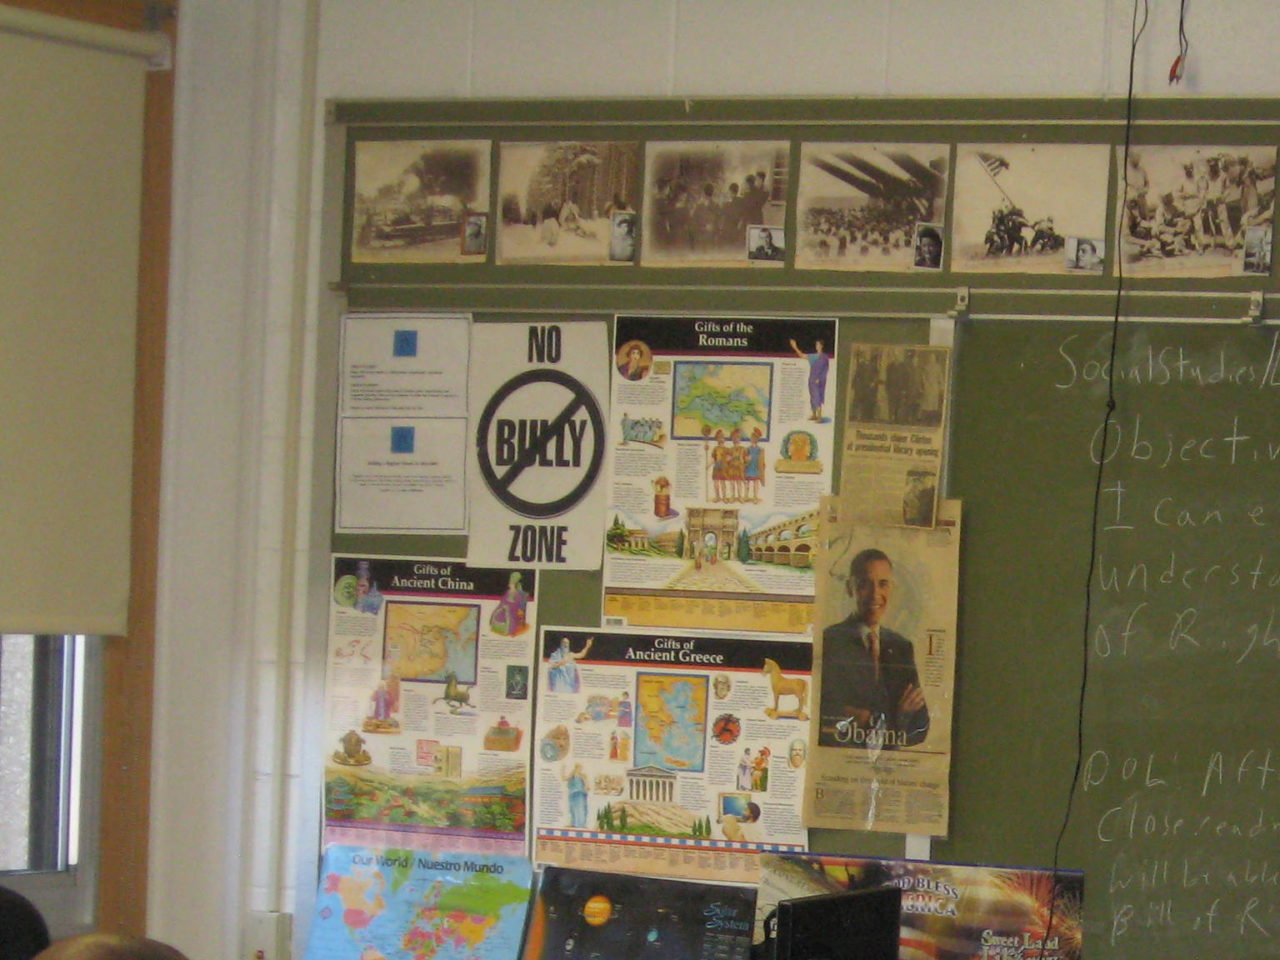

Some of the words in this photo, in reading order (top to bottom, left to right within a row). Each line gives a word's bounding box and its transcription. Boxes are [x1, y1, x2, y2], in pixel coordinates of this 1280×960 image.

[695, 321, 721, 333] Gifts
[722, 321, 736, 333] of
[736, 321, 754, 333] the
[527, 325, 562, 364] NO
[699, 334, 748, 347] Romans
[496, 418, 588, 468] BULLY
[1103, 480, 1134, 530] I
[508, 524, 568, 564] ZONE
[413, 564, 439, 576] Gifts
[440, 565, 452, 576] of
[391, 576, 436, 589] Ancient
[438, 577, 475, 591] China
[1093, 600, 1148, 658] of
[654, 638, 682, 650] Gifts
[683, 639, 697, 650] of
[625, 648, 676, 662] Ancient
[678, 650, 724, 664] Greece
[834, 721, 908, 746] Obama
[352, 854, 374, 866] Our
[375, 854, 409, 869] World
[418, 858, 462, 872] Nuestro
[463, 860, 504, 875] Mundo
[915, 876, 960, 902] BLESS
[901, 891, 959, 918] ERICA
[705, 916, 750, 931] System
[981, 928, 1019, 947] Sweet
[1022, 932, 1060, 950] Land
